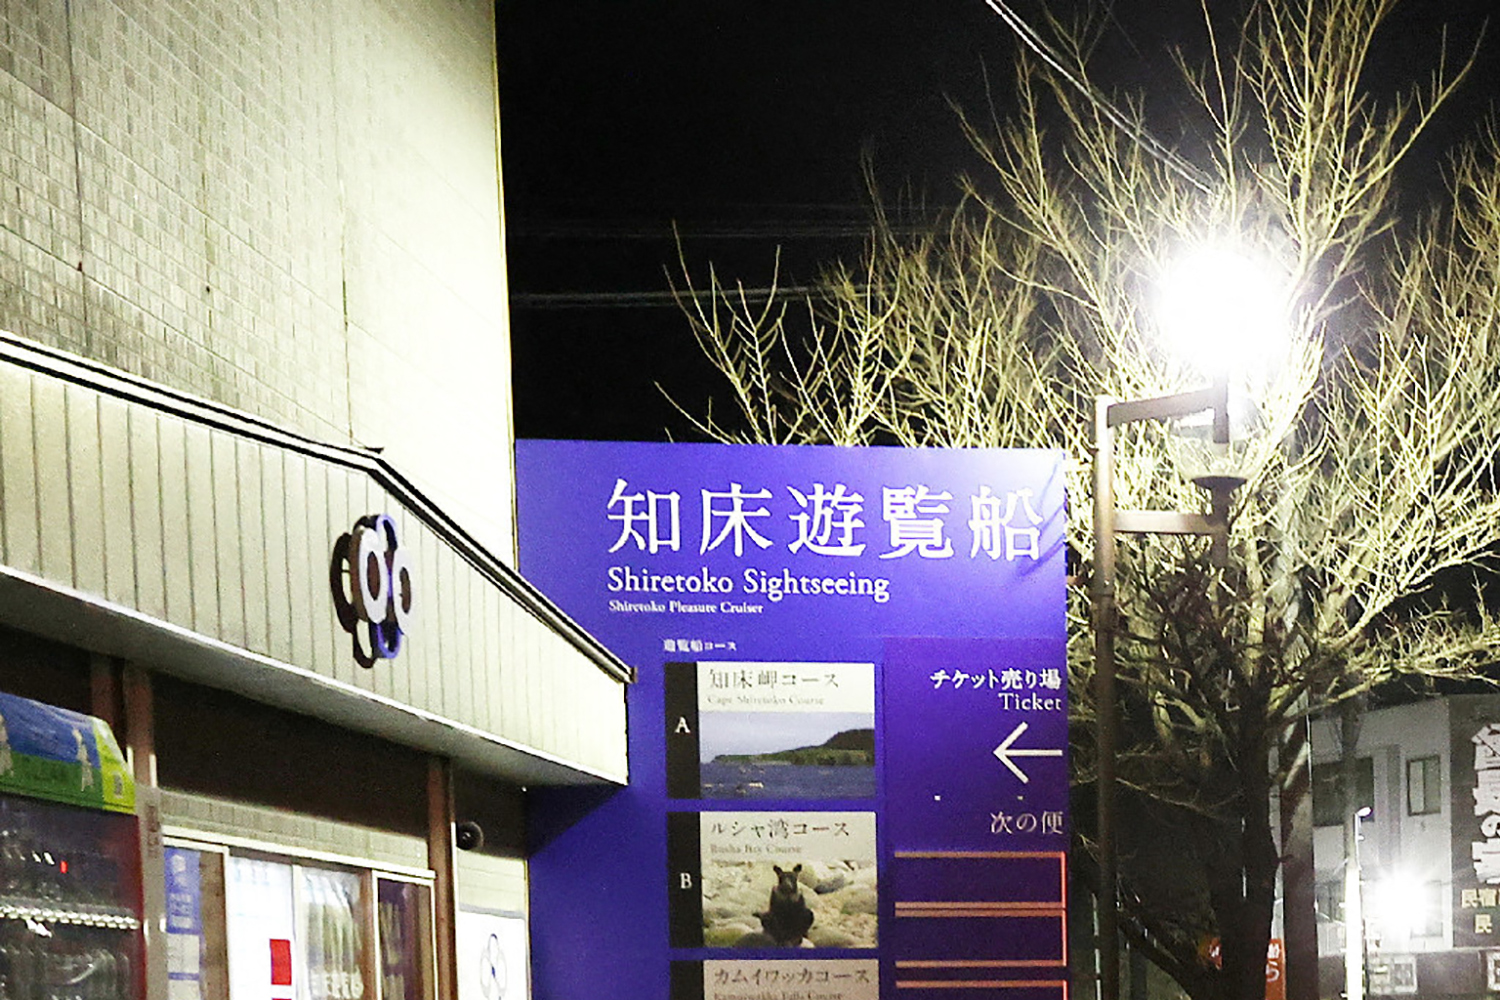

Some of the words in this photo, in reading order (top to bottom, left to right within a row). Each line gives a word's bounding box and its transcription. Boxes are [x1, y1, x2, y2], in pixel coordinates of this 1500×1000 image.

[606, 477, 1044, 562] 知床遊覧船
[607, 566, 734, 595] Shiretoko
[743, 567, 891, 603] Sightseeing
[608, 600, 667, 614] Shiretoko
[669, 601, 718, 614] Pleasure
[720, 601, 764, 614] Cruiser
[709, 668, 840, 690] 知床岬コース
[930, 668, 1063, 691] チケット売り場
[998, 692, 1063, 712] Ticket
[675, 716, 691, 734] A
[710, 818, 850, 840] ルシャ湾コース
[990, 810, 1064, 835] 次の便
[679, 872, 693, 890] B
[714, 967, 870, 987] カムイワッカコース
